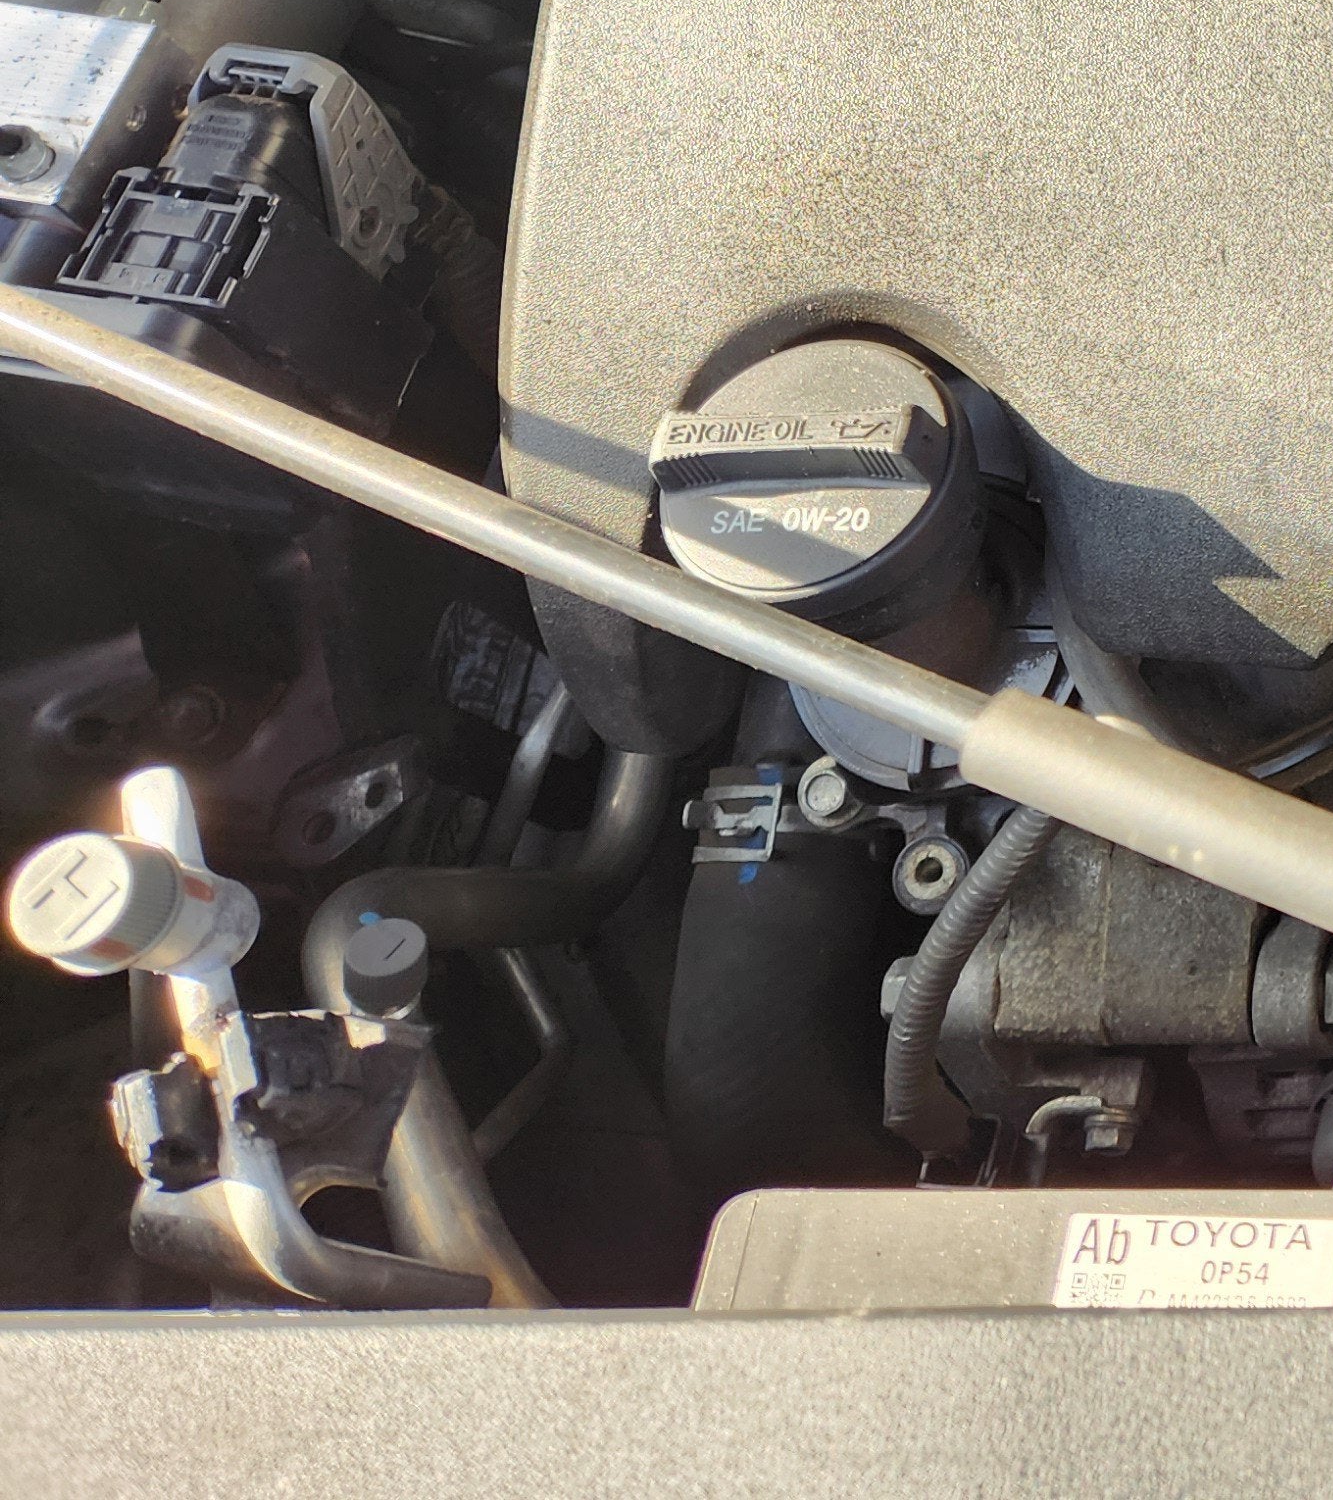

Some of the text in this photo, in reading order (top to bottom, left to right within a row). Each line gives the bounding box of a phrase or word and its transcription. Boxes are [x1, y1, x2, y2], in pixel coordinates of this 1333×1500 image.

[667, 419, 815, 444] ENGINE OIL
[710, 506, 870, 534] SAE 0W-20
[1073, 1218, 1313, 1265] Ab TOYOTA
